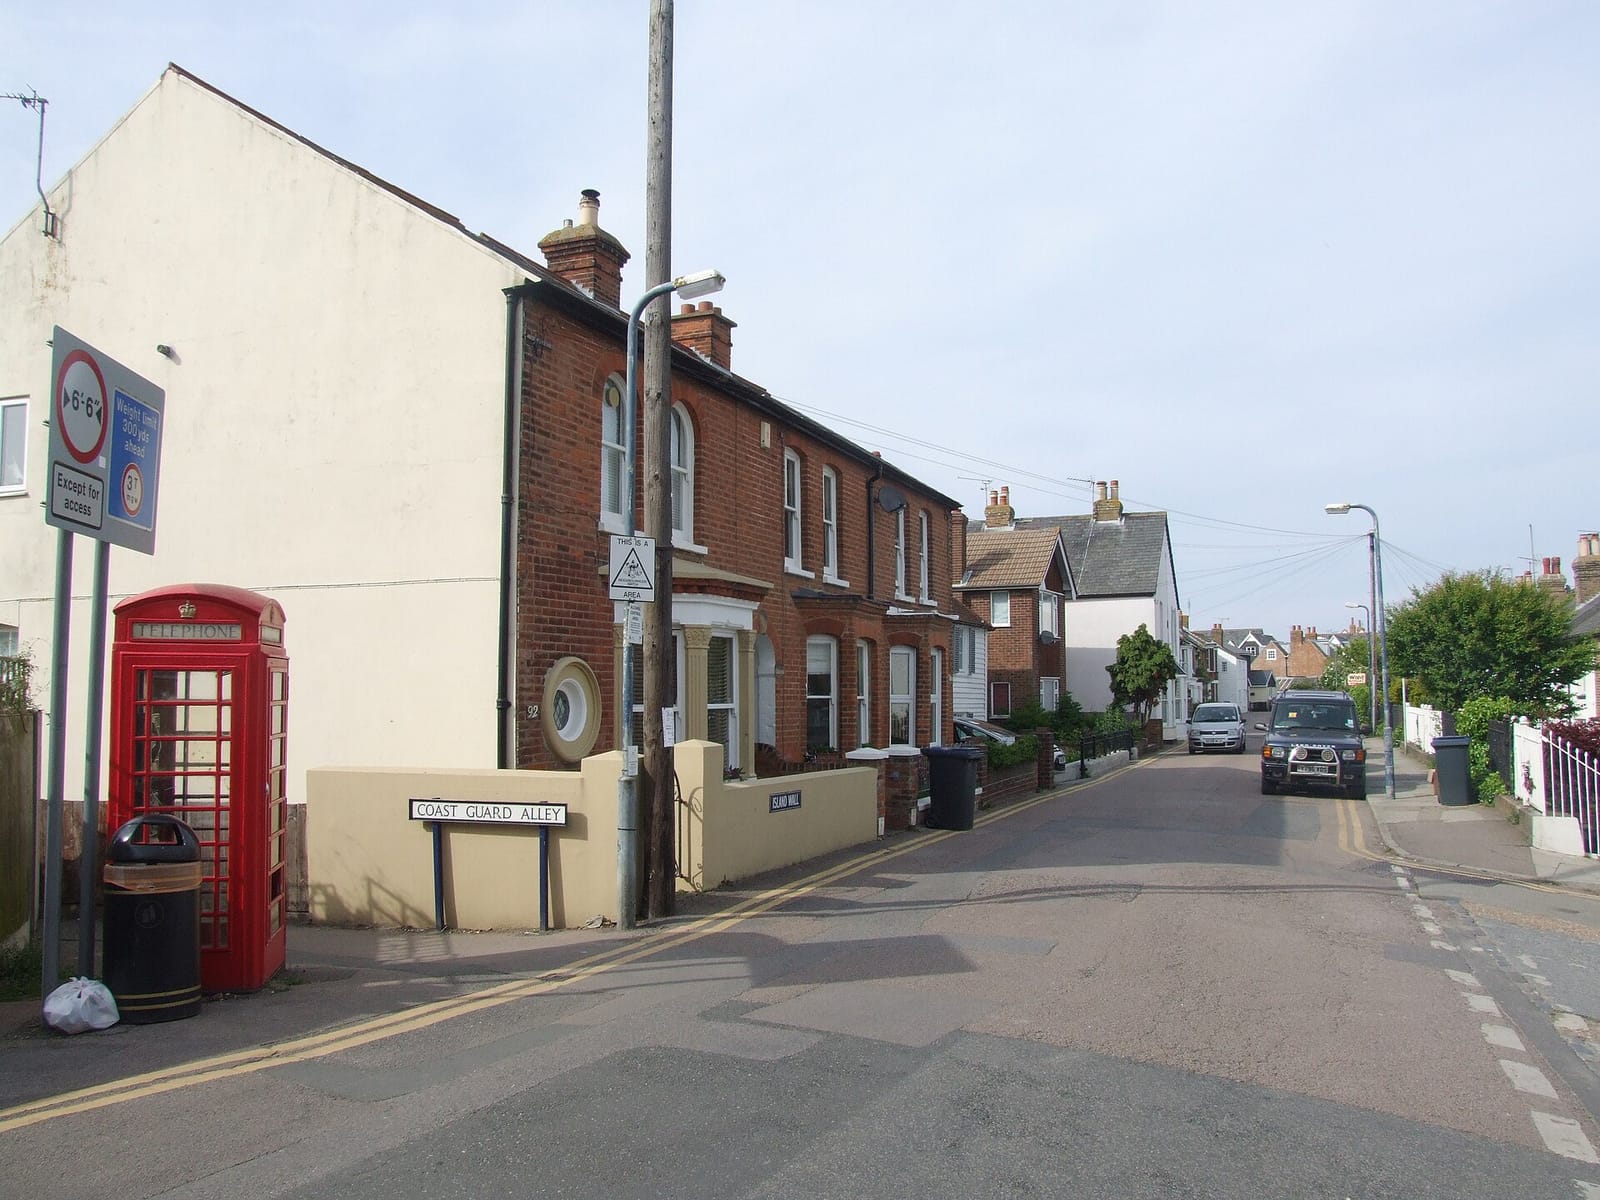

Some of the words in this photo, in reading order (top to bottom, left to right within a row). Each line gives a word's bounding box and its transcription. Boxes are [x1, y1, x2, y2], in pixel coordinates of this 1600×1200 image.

[116, 398, 141, 422] Weight
[122, 418, 138, 437] 300
[138, 429, 150, 444] yds
[124, 439, 146, 458] ahead
[58, 472, 86, 496] Except
[88, 484, 100, 500] for
[64, 498, 92, 516] access
[617, 538, 632, 546] THIS
[634, 539, 642, 547] IS
[623, 591, 641, 599] AREA
[138, 624, 237, 638] TELEPHONE
[527, 704, 539, 718] 92
[772, 795, 787, 808] ISLAND
[417, 804, 458, 818] COAST
[466, 805, 512, 820] GUARD
[520, 808, 561, 822] ALLEY
